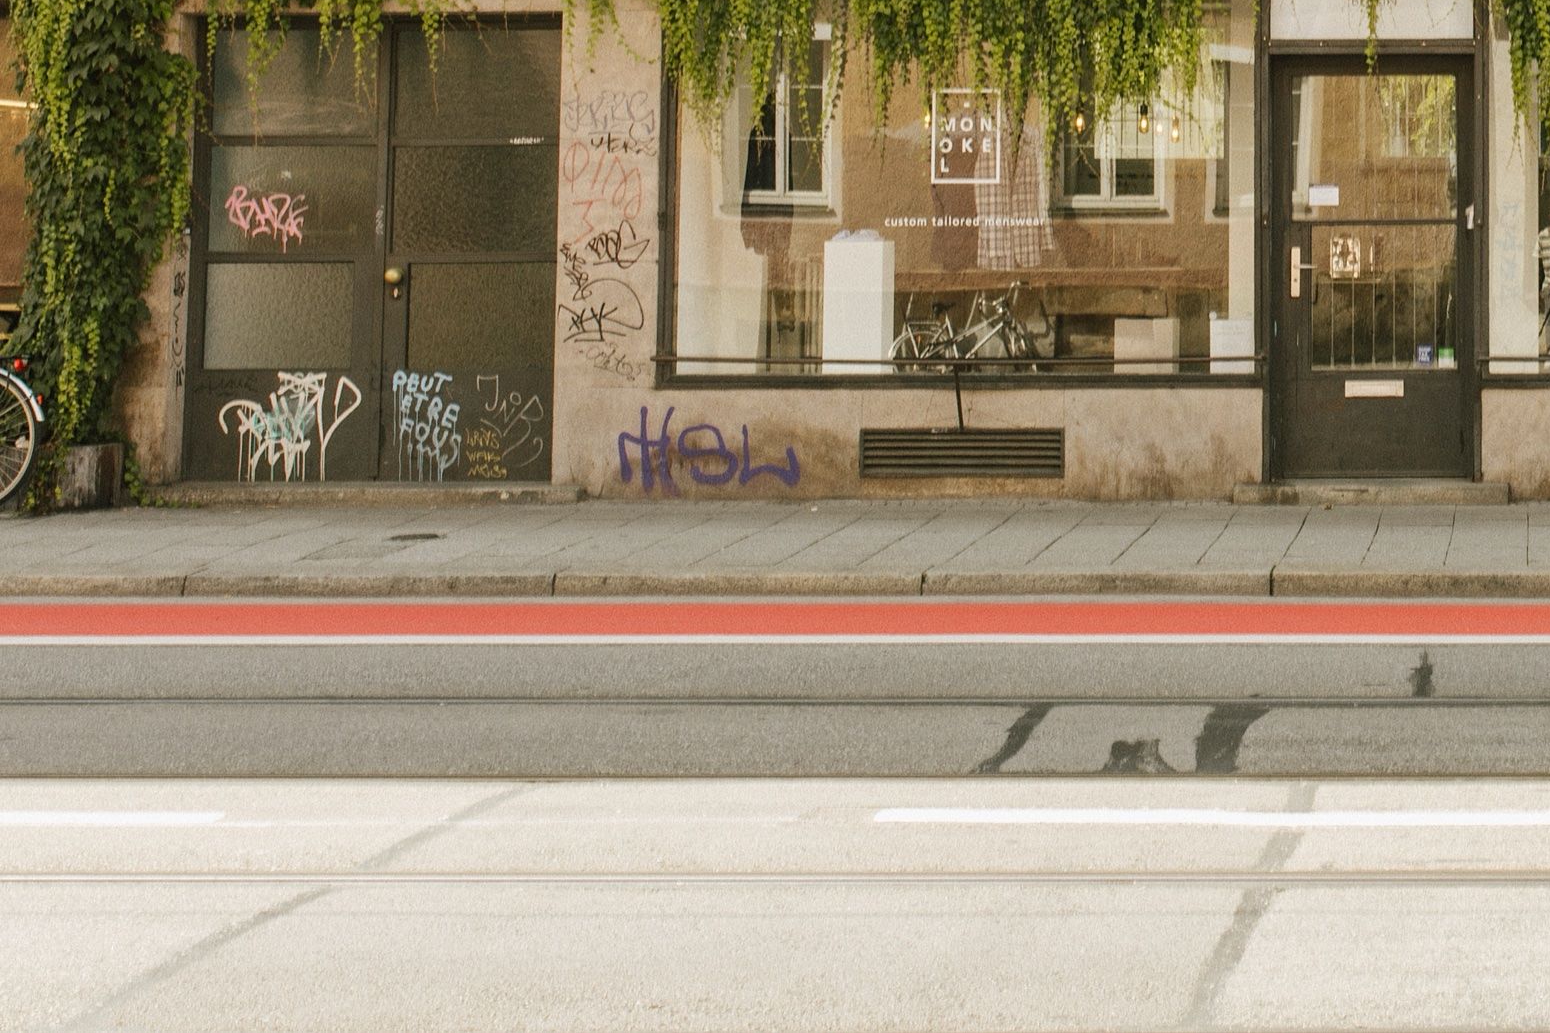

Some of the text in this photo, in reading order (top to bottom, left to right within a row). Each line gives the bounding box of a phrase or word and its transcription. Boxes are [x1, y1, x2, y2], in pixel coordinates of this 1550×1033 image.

[939, 117, 992, 132] MON
[939, 138, 992, 154] OKE
[940, 157, 949, 173] L
[884, 215, 1044, 227] custom tailored menswear
